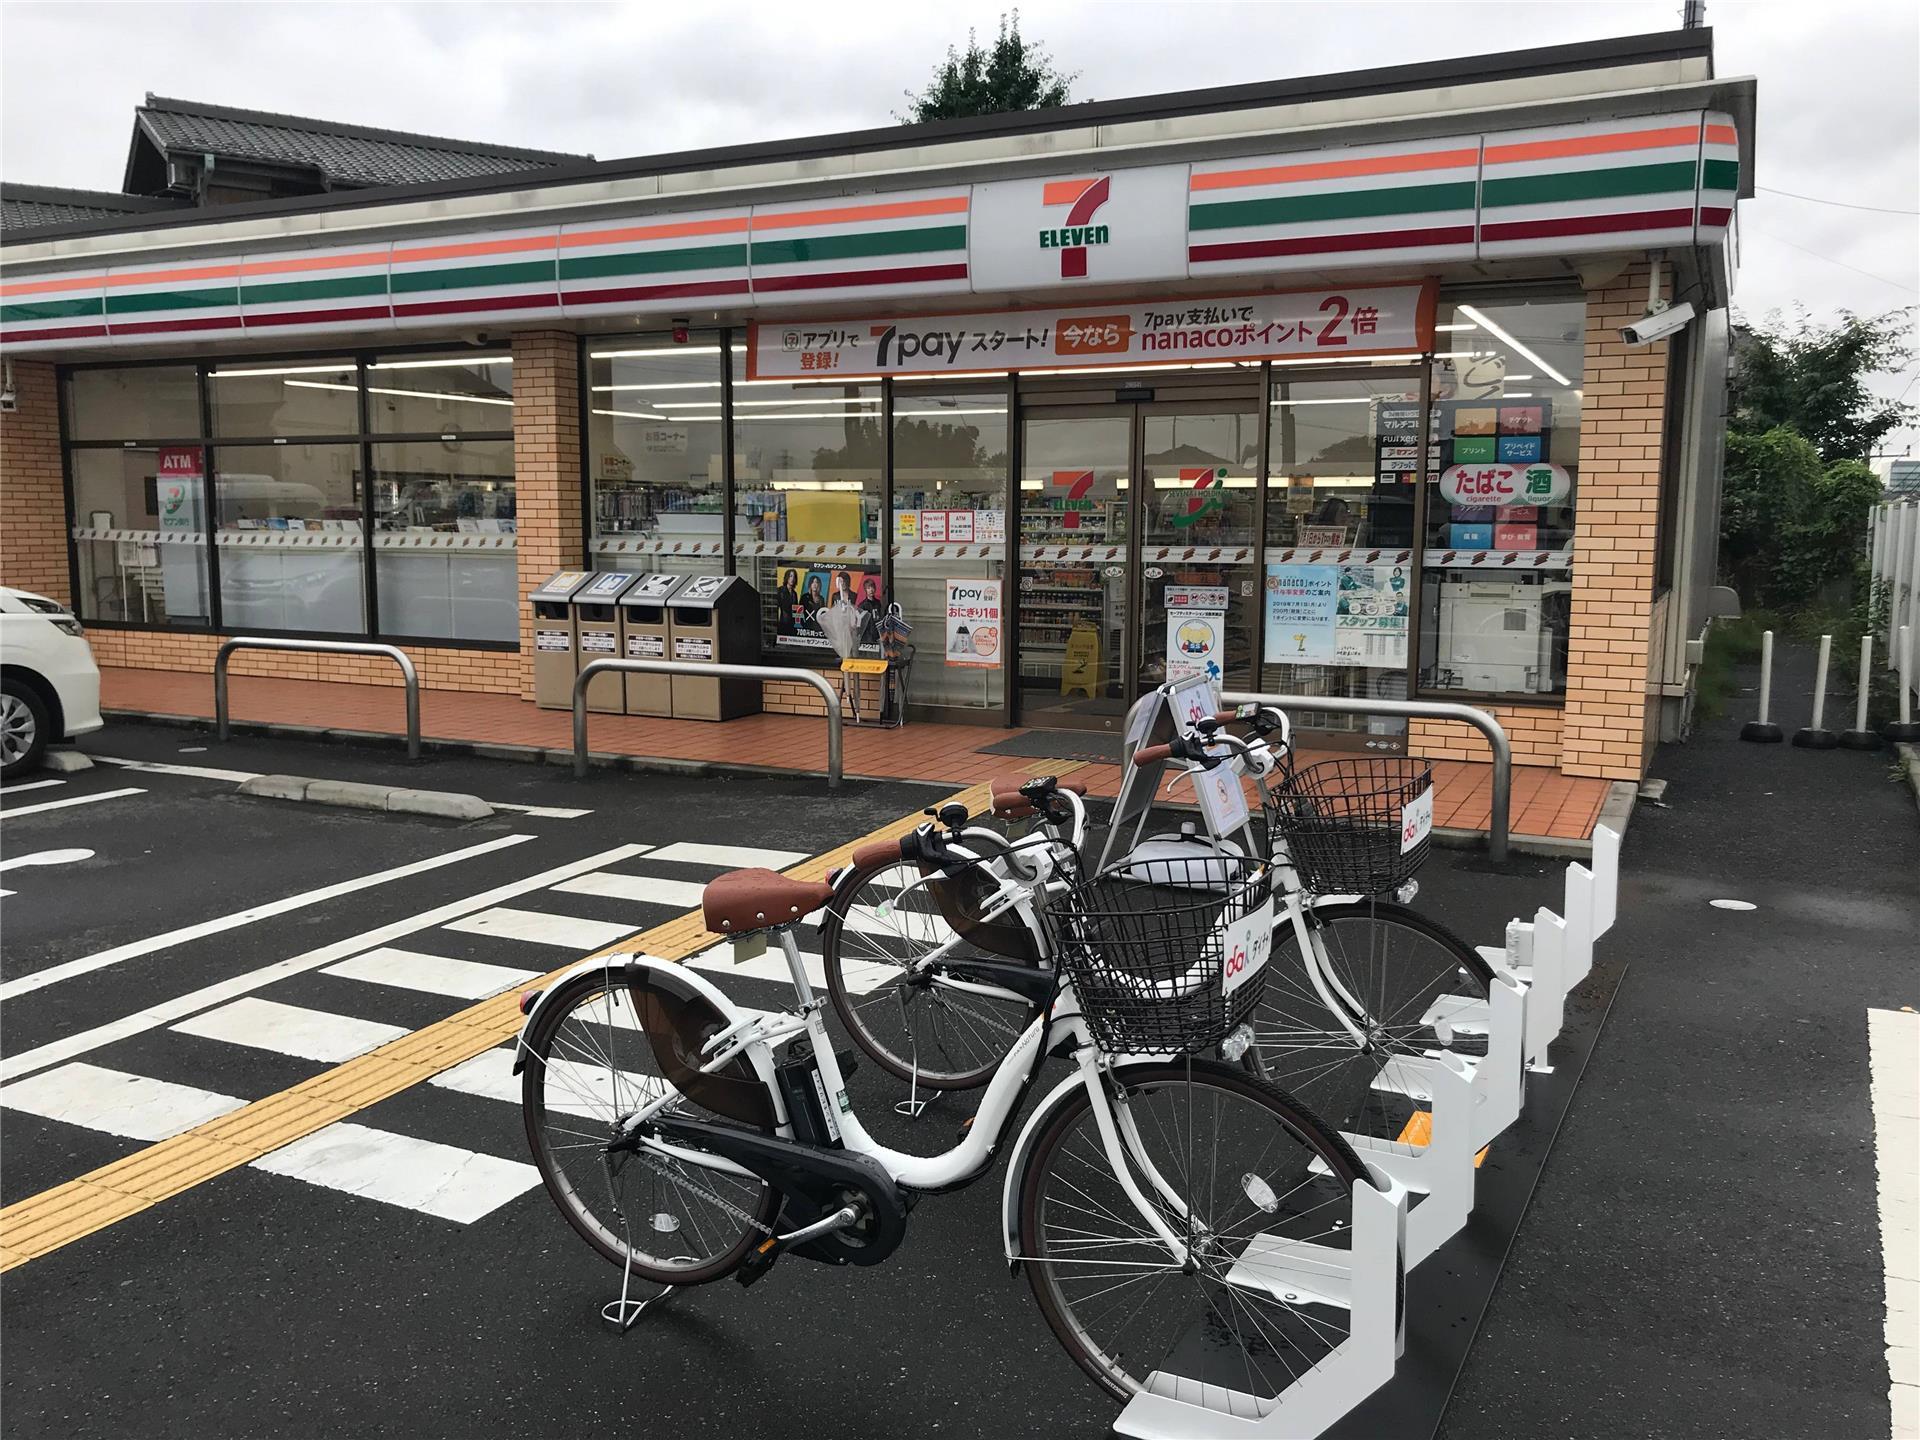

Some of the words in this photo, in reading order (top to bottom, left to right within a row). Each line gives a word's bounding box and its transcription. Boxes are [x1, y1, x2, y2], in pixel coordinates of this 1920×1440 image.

[1043, 176, 1110, 278] 7
[1144, 306, 1253, 329] 7pay支払いで
[803, 329, 859, 350] アプリで
[870, 325, 966, 366] 7pay
[1062, 323, 1121, 349] 今なら
[800, 351, 839, 370] 登録!
[163, 454, 192, 469] ATM
[1455, 469, 1514, 495] たばこ
[1525, 469, 1553, 495] 酒
[1466, 495, 1502, 503] cigarette
[949, 586, 982, 601] 7pay
[948, 607, 999, 619] おにぎり1個
[1226, 929, 1251, 978] dai
